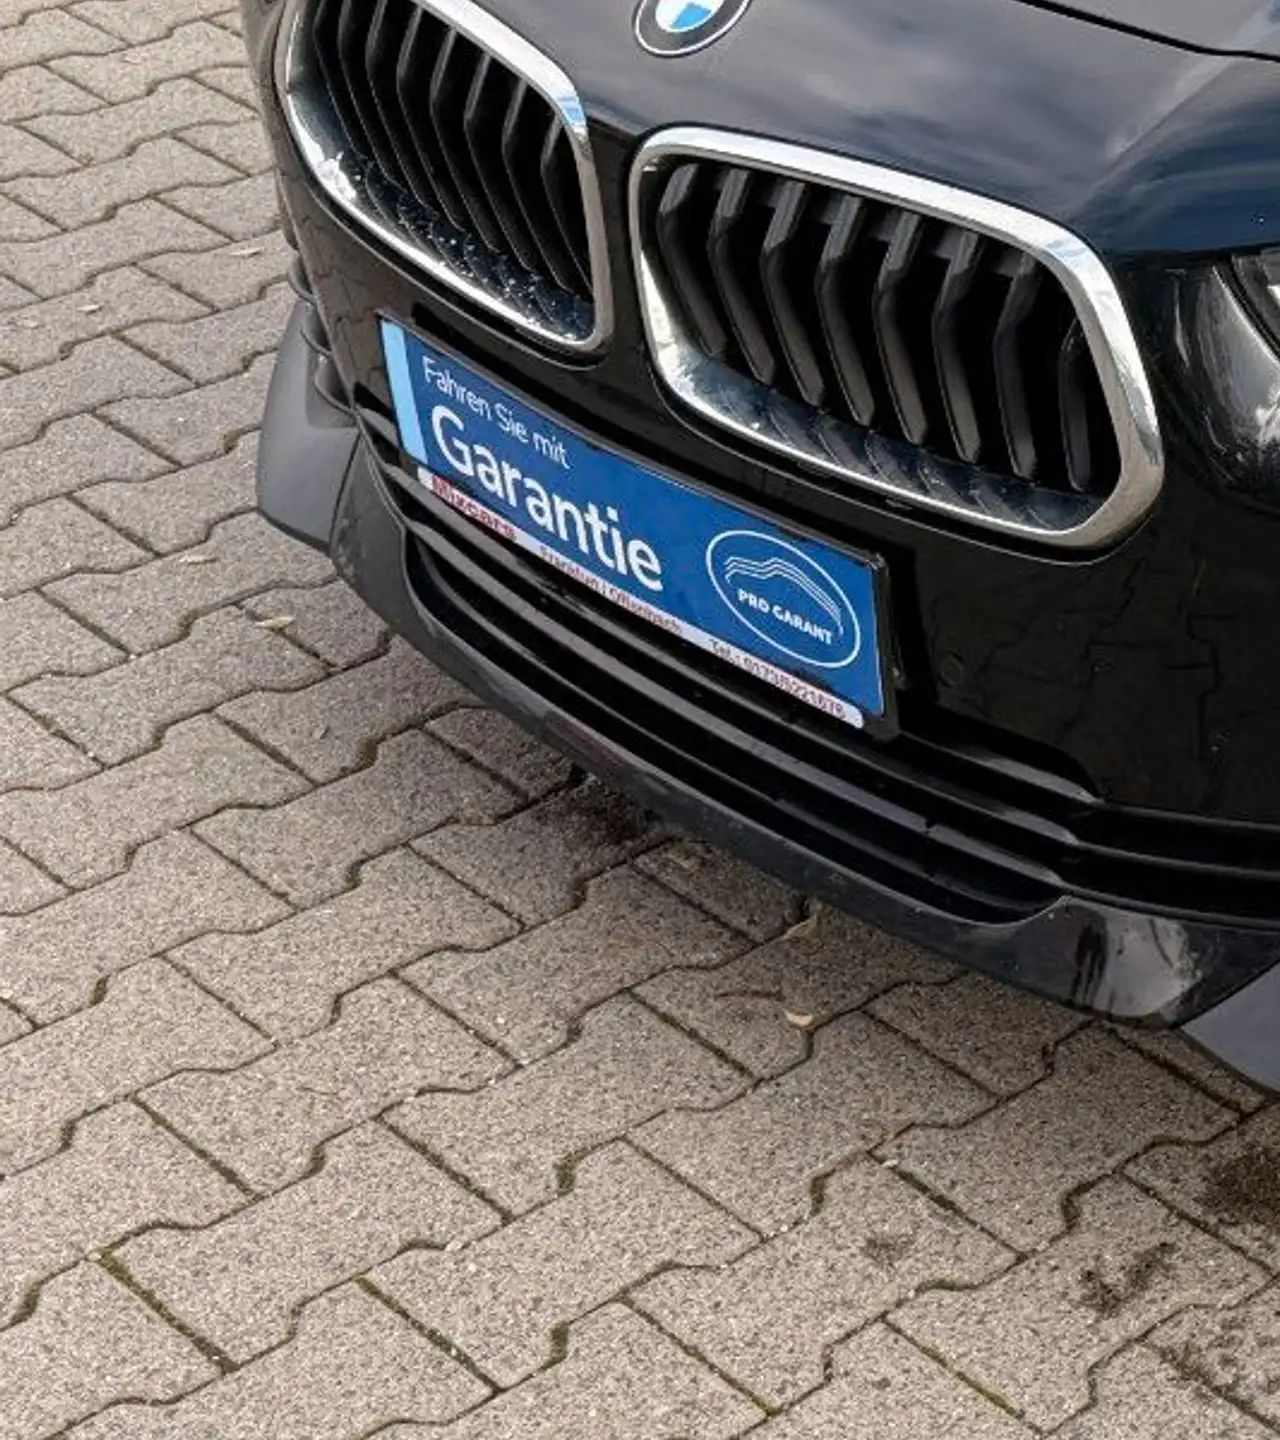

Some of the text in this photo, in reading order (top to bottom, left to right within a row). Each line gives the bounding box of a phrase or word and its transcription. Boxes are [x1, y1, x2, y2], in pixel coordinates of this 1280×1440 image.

[423, 355, 571, 469] Fahren Sie mit
[431, 405, 664, 592] Garantie
[737, 588, 832, 645] PRO GARANT
